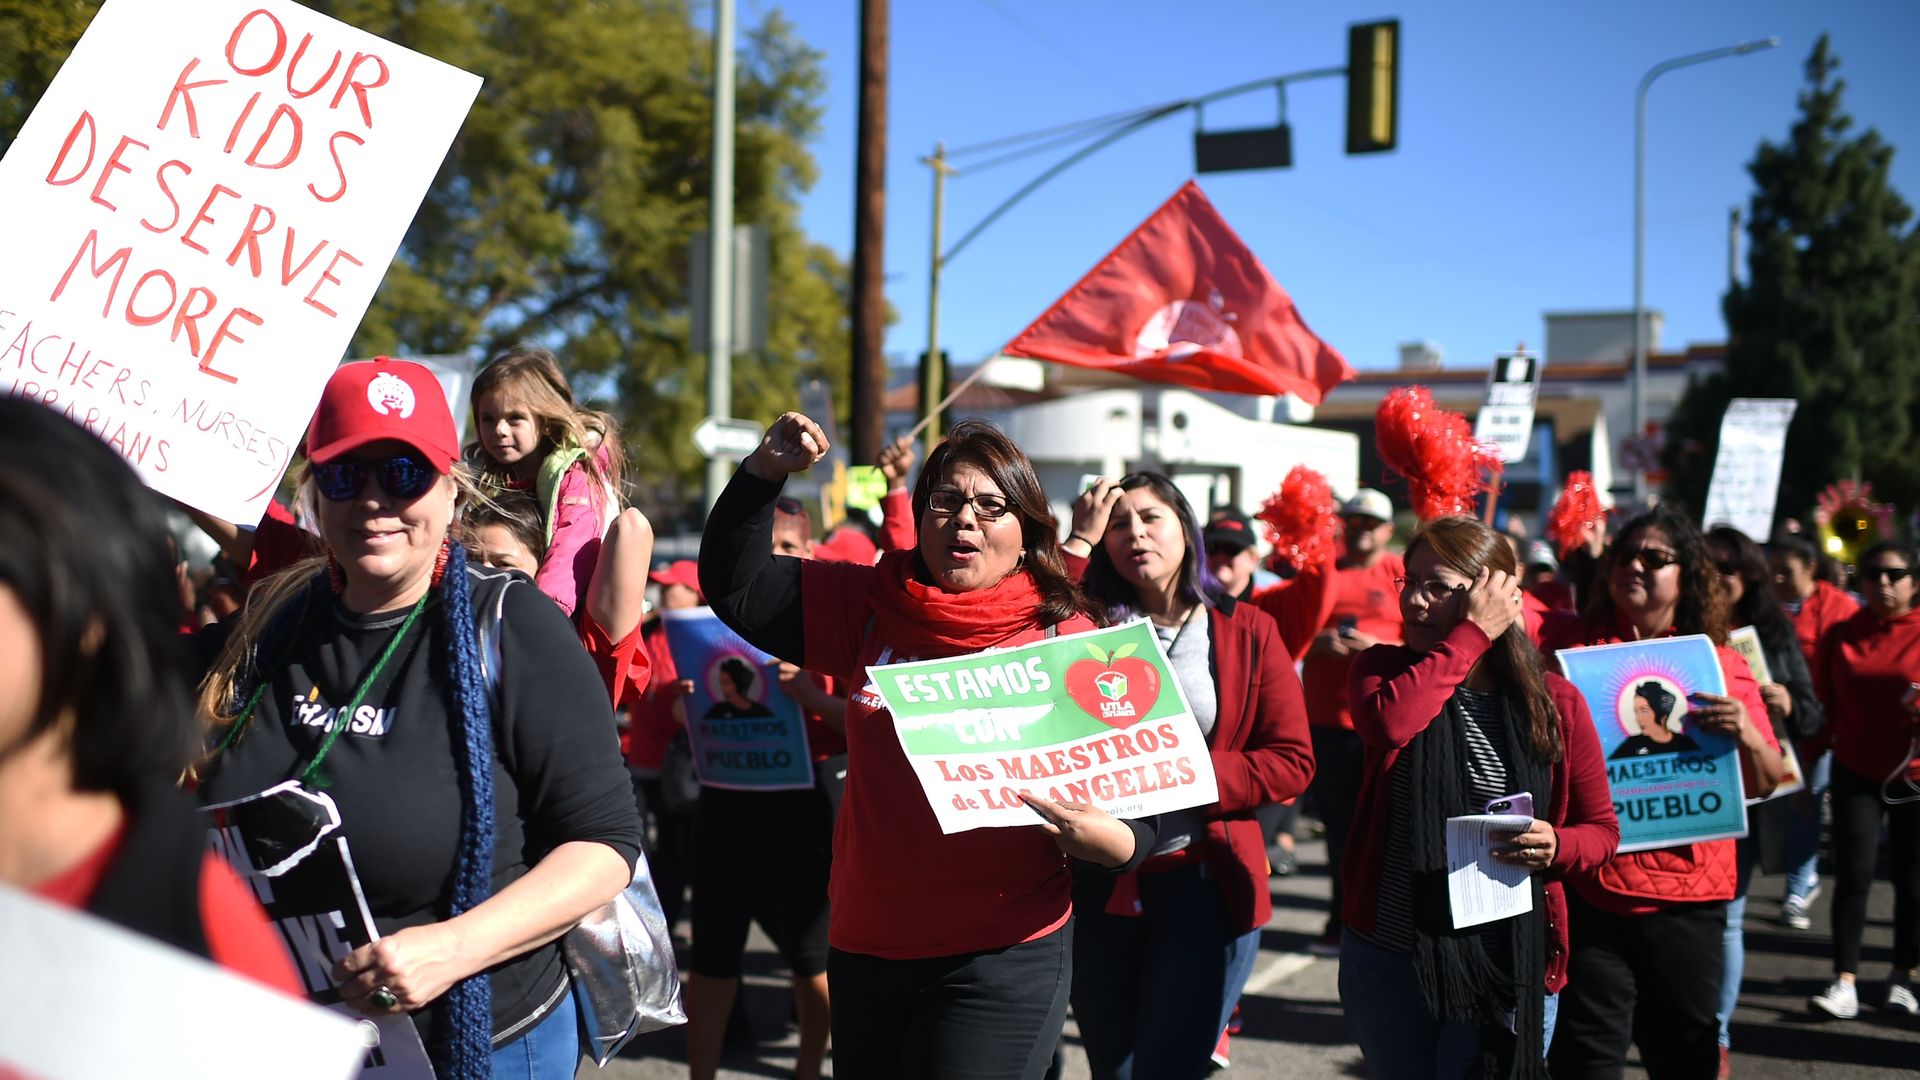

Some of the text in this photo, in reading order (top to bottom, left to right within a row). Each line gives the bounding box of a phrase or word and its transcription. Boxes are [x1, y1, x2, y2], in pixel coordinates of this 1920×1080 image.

[225, 8, 390, 128] OUR
[157, 57, 365, 202] KIDS
[46, 110, 364, 318] DESERVE
[50, 229, 264, 384] MORE
[894, 655, 1051, 703] ESTAMOS
[954, 708, 1021, 744] CON
[1100, 700, 1136, 712] UTLA
[706, 750, 792, 769] PUEBLO
[996, 723, 1180, 781] MAESTROS
[1606, 756, 1717, 784] MAESTROS
[952, 793, 979, 811] de
[1050, 756, 1197, 806] ANGELES
[1613, 790, 1722, 822] PUEBLO
